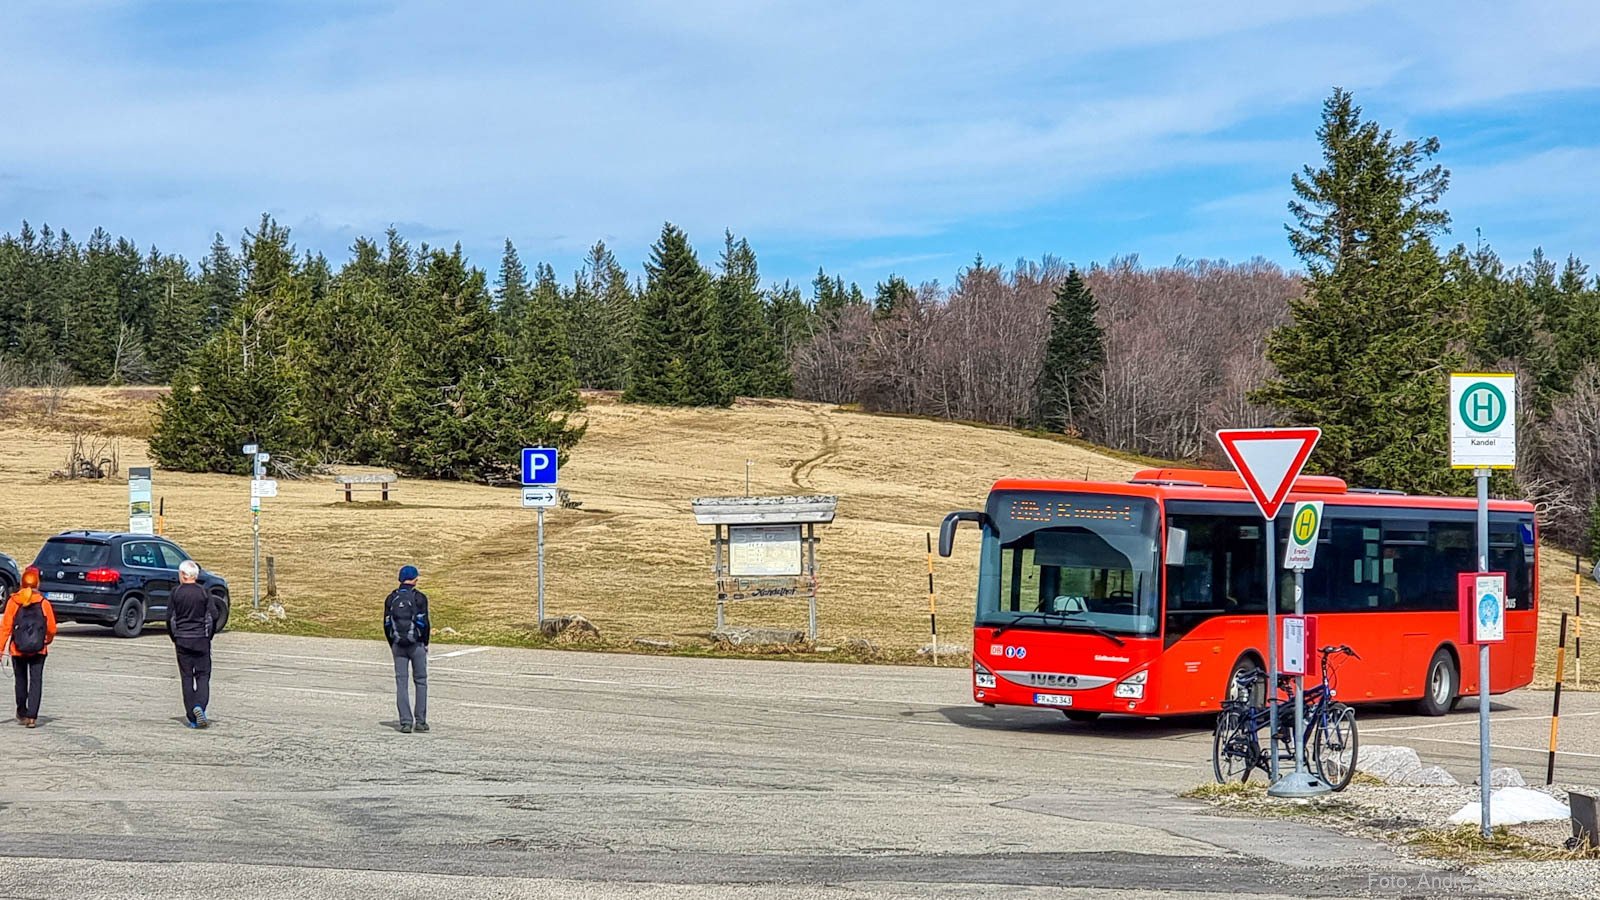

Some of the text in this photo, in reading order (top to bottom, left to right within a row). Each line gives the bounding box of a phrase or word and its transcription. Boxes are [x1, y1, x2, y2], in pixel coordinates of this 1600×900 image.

[1473, 393, 1493, 422] H
[530, 453, 549, 480] P
[1299, 512, 1313, 537] H
[992, 646, 1002, 654] DB
[1030, 673, 1078, 688] IVECO
